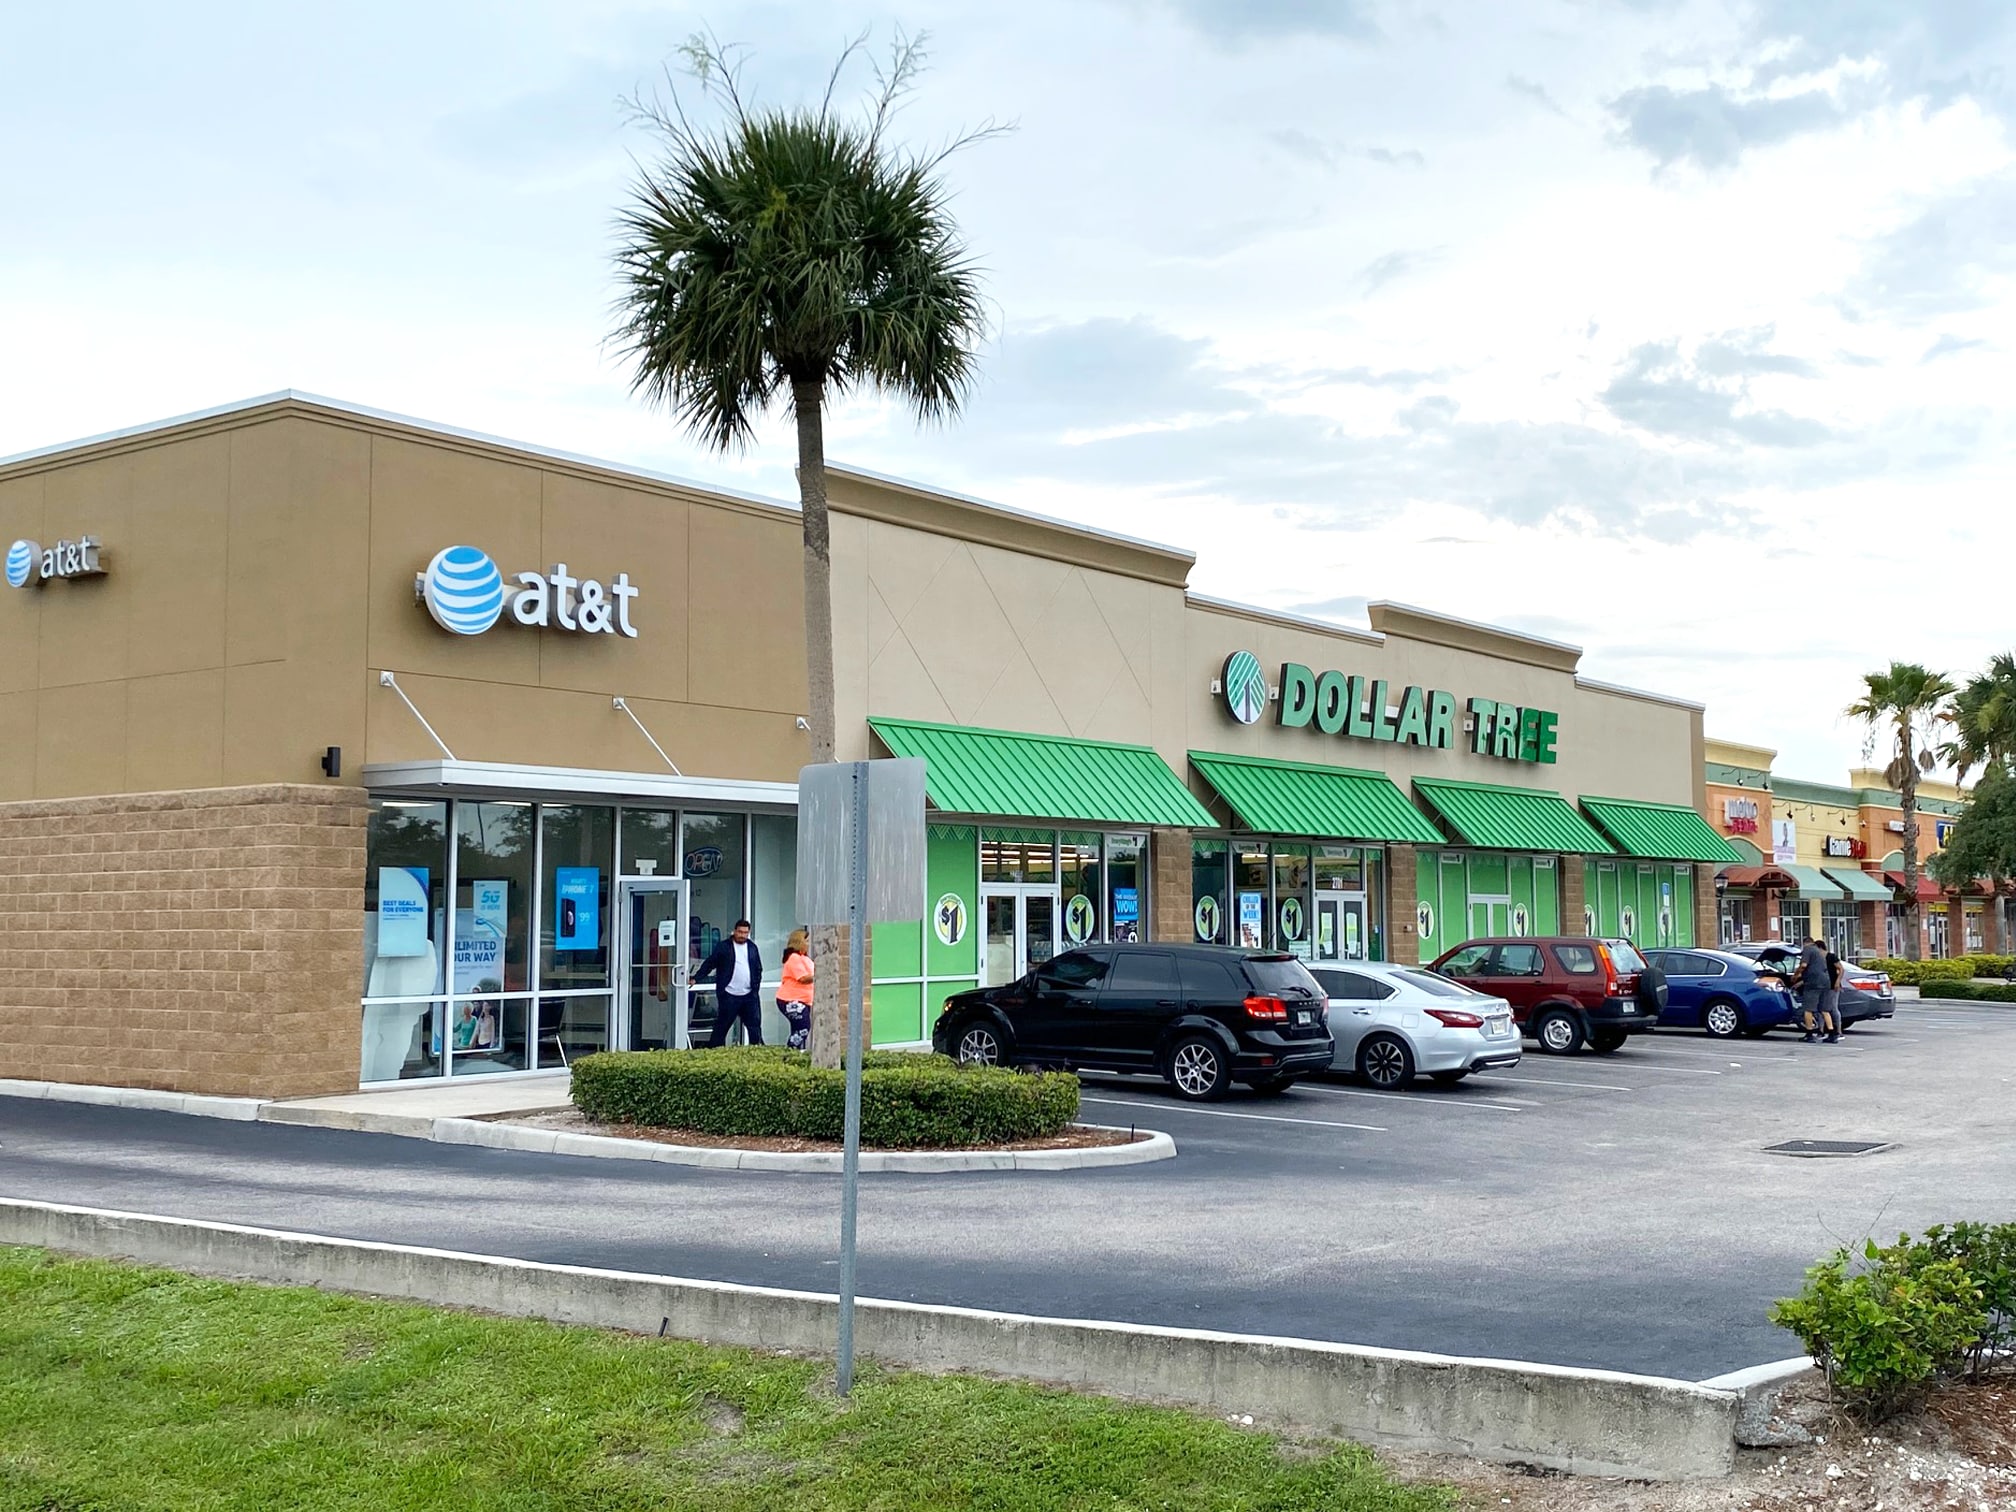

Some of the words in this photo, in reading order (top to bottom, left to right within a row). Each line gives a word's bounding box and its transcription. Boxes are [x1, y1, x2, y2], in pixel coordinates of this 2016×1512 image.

[41, 535, 91, 578] at&t
[512, 563, 640, 638] at&t
[1277, 662, 1456, 749] DOLLAR
[1467, 697, 1559, 764] TREE
[686, 853, 722, 873] OPEN
[481, 891, 500, 903] 5G
[941, 905, 959, 943] $1
[1072, 905, 1087, 941] $1
[1200, 906, 1214, 939] $1
[1285, 906, 1298, 939] $1
[455, 941, 497, 950] LIMITED
[474, 952, 496, 962] WAY
